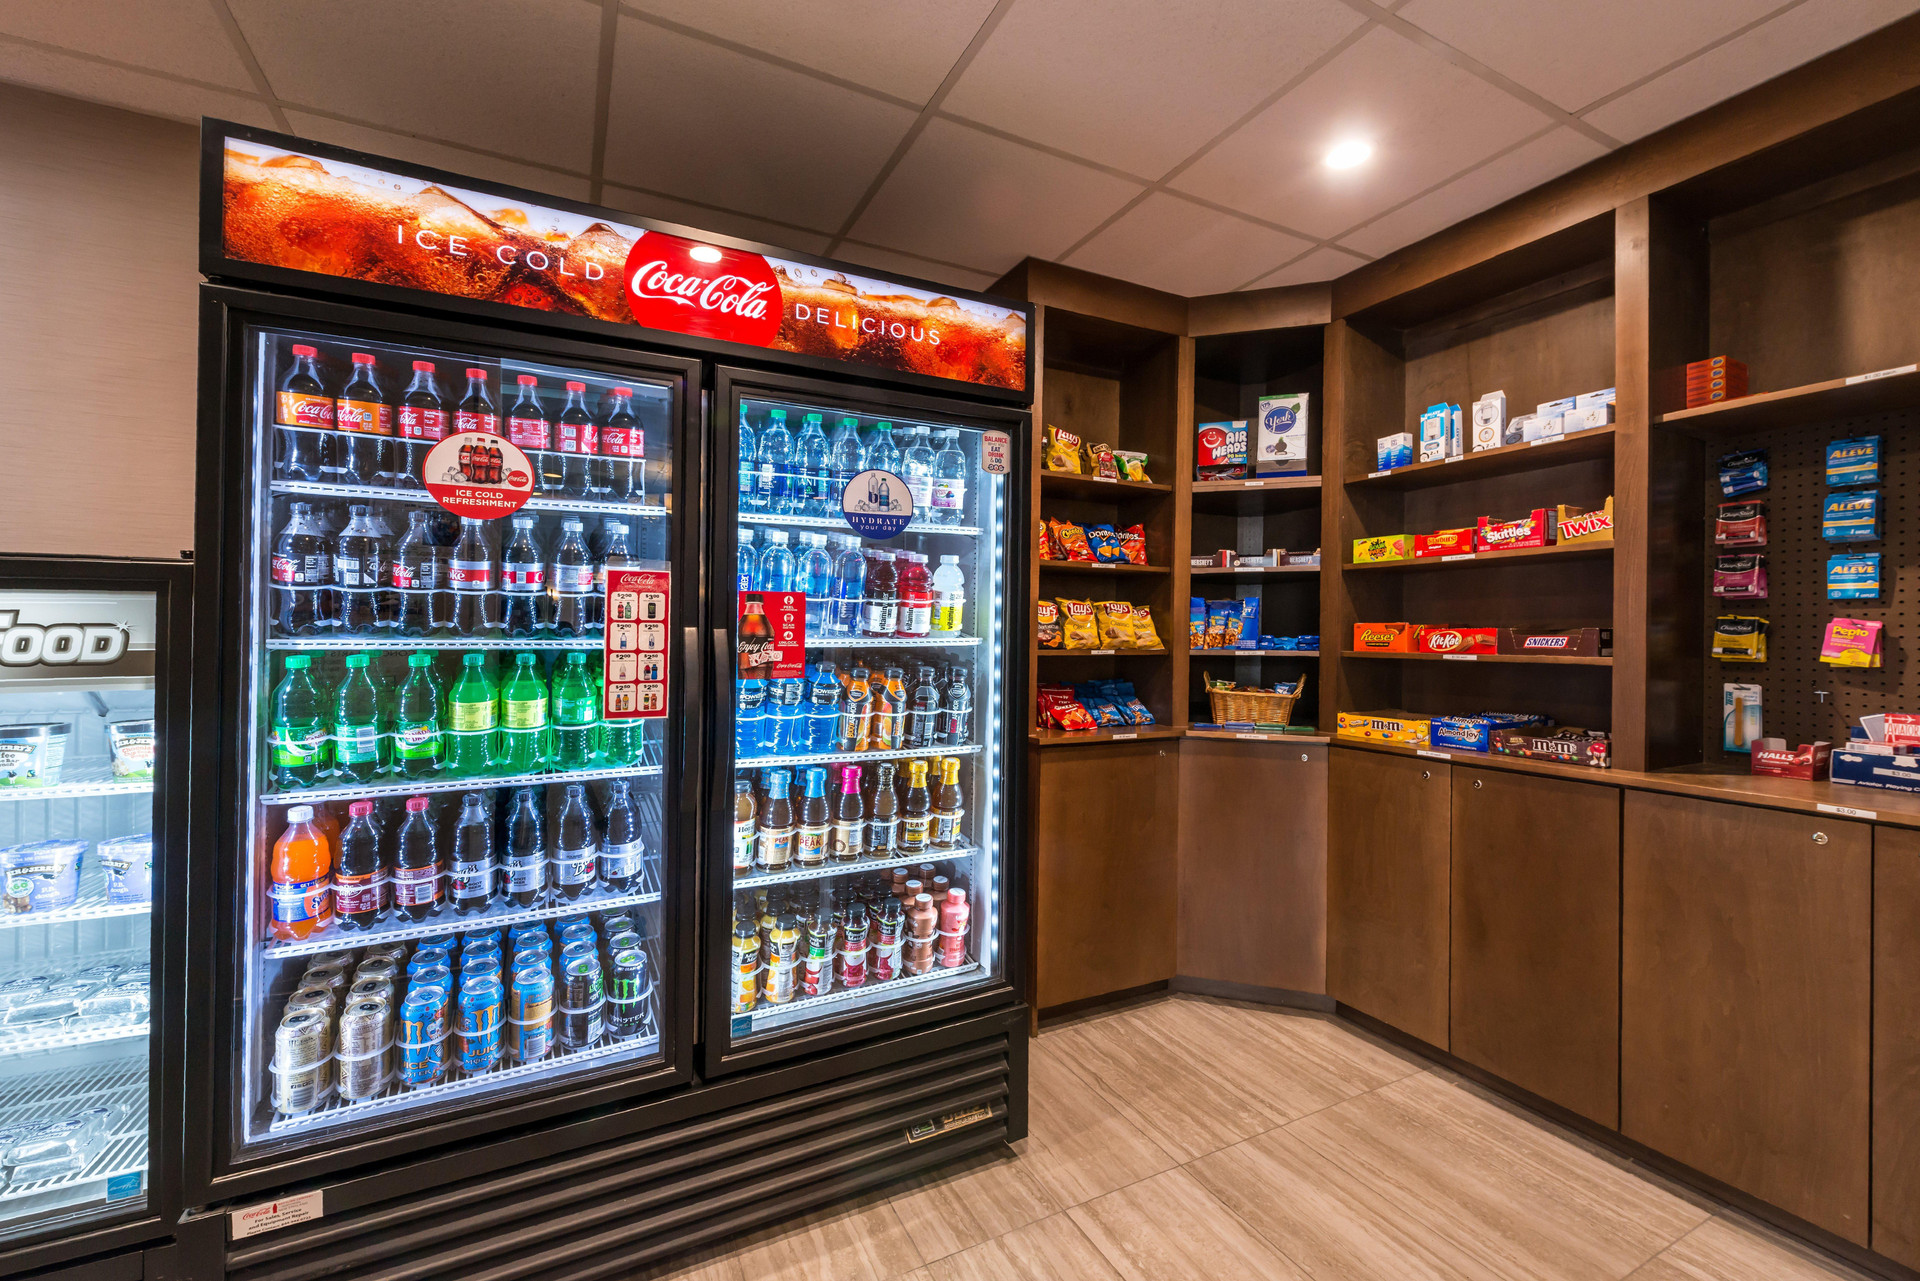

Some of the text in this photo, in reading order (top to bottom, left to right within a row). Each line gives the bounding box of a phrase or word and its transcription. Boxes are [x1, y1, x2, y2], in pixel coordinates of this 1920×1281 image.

[396, 223, 604, 281] ICE COLD
[631, 260, 777, 320] Coca-Cola
[795, 302, 942, 346] DELICIOUS
[1265, 410, 1292, 433] York
[984, 436, 1008, 444] BALANCE
[1225, 431, 1247, 444] AIR
[1212, 442, 1247, 460] HEADS
[1830, 448, 1875, 459] ALEVE
[456, 489, 504, 499] ICE COLD
[442, 496, 517, 509] REFRESHMENT
[1827, 502, 1872, 512] ALEVE
[852, 516, 905, 526] HYDRATE
[1558, 516, 1613, 539] Twix
[1487, 527, 1531, 543] Skittles
[1831, 566, 1876, 574] ALEVE
[449, 572, 465, 581] oke
[620, 573, 657, 585] Coca-Cola
[1038, 605, 1057, 616] ay's
[1071, 603, 1092, 615] Lay's
[1107, 603, 1128, 614] Lay's
[1133, 608, 1148, 617] ay's
[1361, 629, 1395, 641] Reese's
[1833, 626, 1869, 637] Pepto
[738, 642, 760, 653] Enjoy
[1525, 637, 1567, 648] SNICKERS
[1438, 727, 1479, 739] Almond Joy
[1757, 752, 1794, 761] HALLS
[1836, 807, 1856, 816] $3.00
[468, 1046, 499, 1057] JUIC
[282, 1208, 302, 1216] Service
[260, 1216, 291, 1228] Equipment
[292, 1211, 309, 1219] Repair
